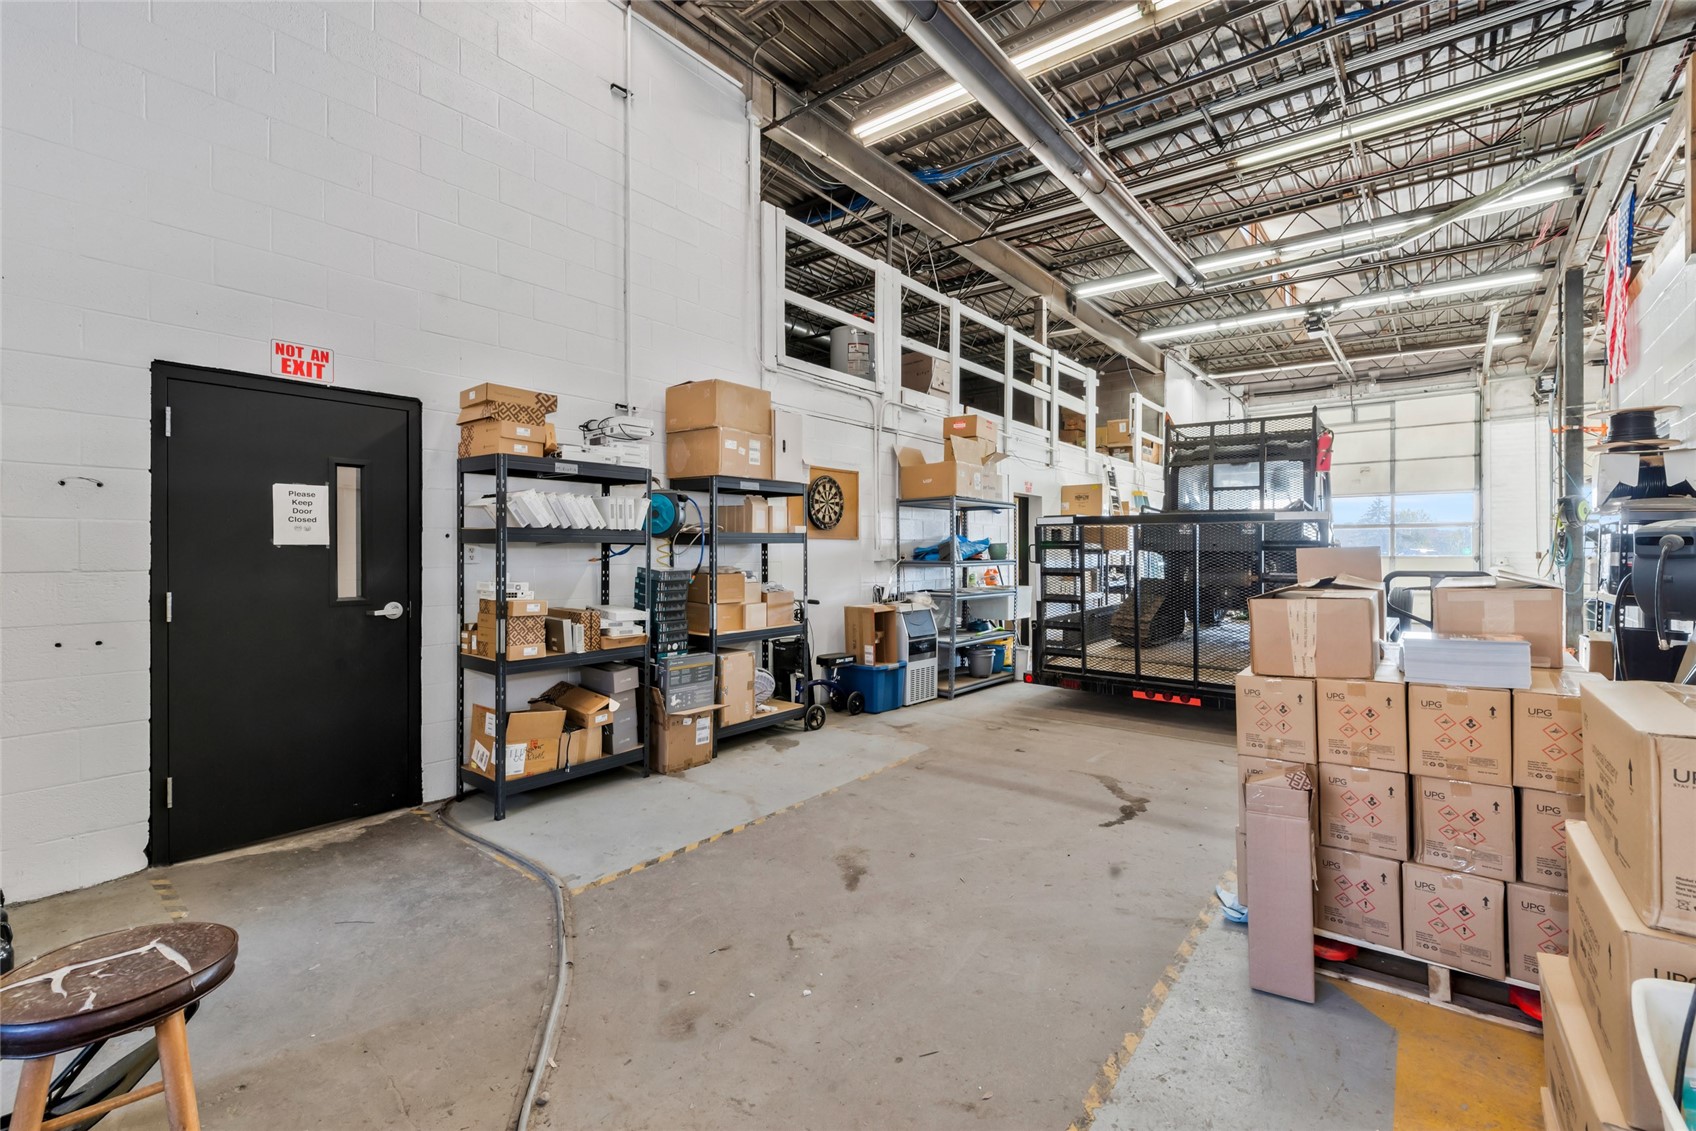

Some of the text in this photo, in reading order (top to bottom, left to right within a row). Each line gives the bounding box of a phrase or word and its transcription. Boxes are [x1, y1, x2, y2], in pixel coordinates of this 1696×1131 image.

[275, 342, 330, 363] NOT AN
[281, 357, 326, 380] EXIT
[288, 490, 316, 498] Please
[291, 499, 313, 507] Keep
[292, 507, 313, 515] Door
[287, 515, 317, 523] Closed
[1244, 688, 1261, 696] UPG
[1326, 692, 1345, 700] UPG
[1420, 699, 1443, 709] UPG
[1527, 707, 1553, 717] UPG
[1328, 776, 1347, 786] UPG
[1424, 790, 1446, 800] UPG
[1536, 803, 1561, 815] UPG
[1322, 859, 1341, 870] UPG
[1414, 880, 1436, 892] UPG
[1521, 900, 1546, 913] UPG
